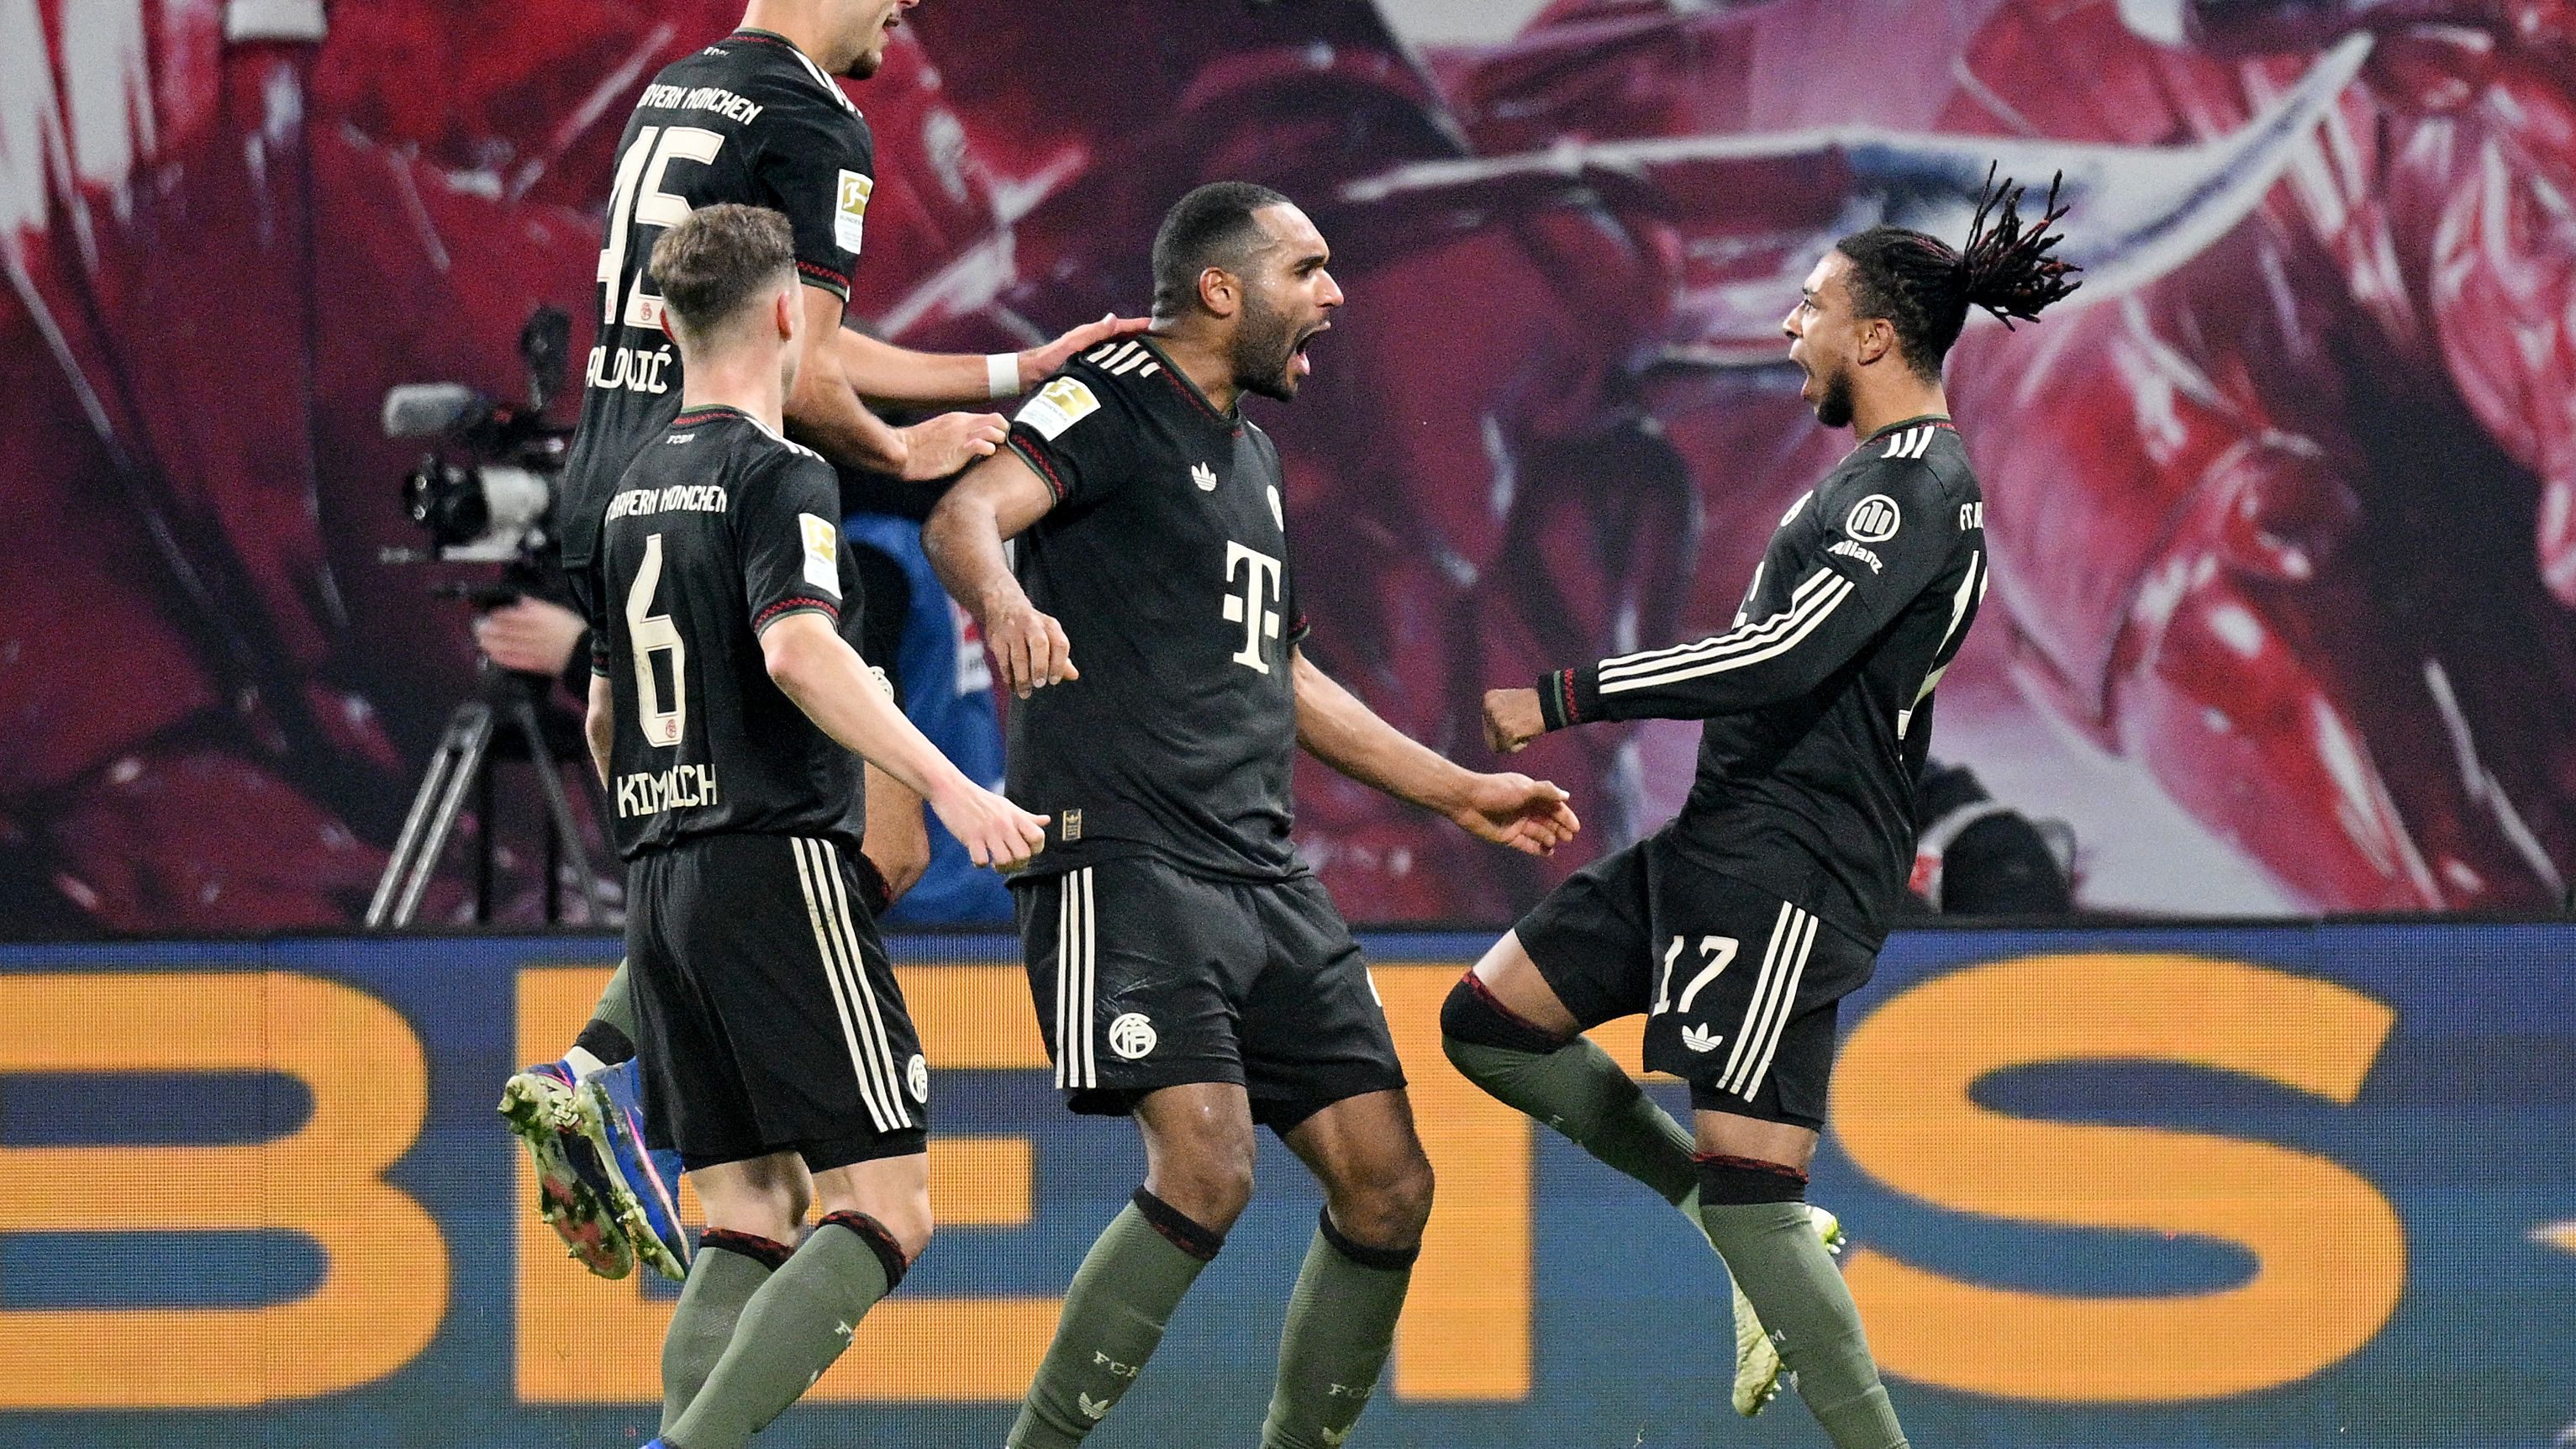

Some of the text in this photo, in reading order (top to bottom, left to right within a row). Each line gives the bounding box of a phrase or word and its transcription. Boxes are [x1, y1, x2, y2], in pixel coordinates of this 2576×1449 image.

[587, 344, 672, 394] ALOVIĆ
[1827, 540, 1883, 575] Allianz
[625, 533, 686, 747] 6
[1651, 935, 1739, 1017] 17
